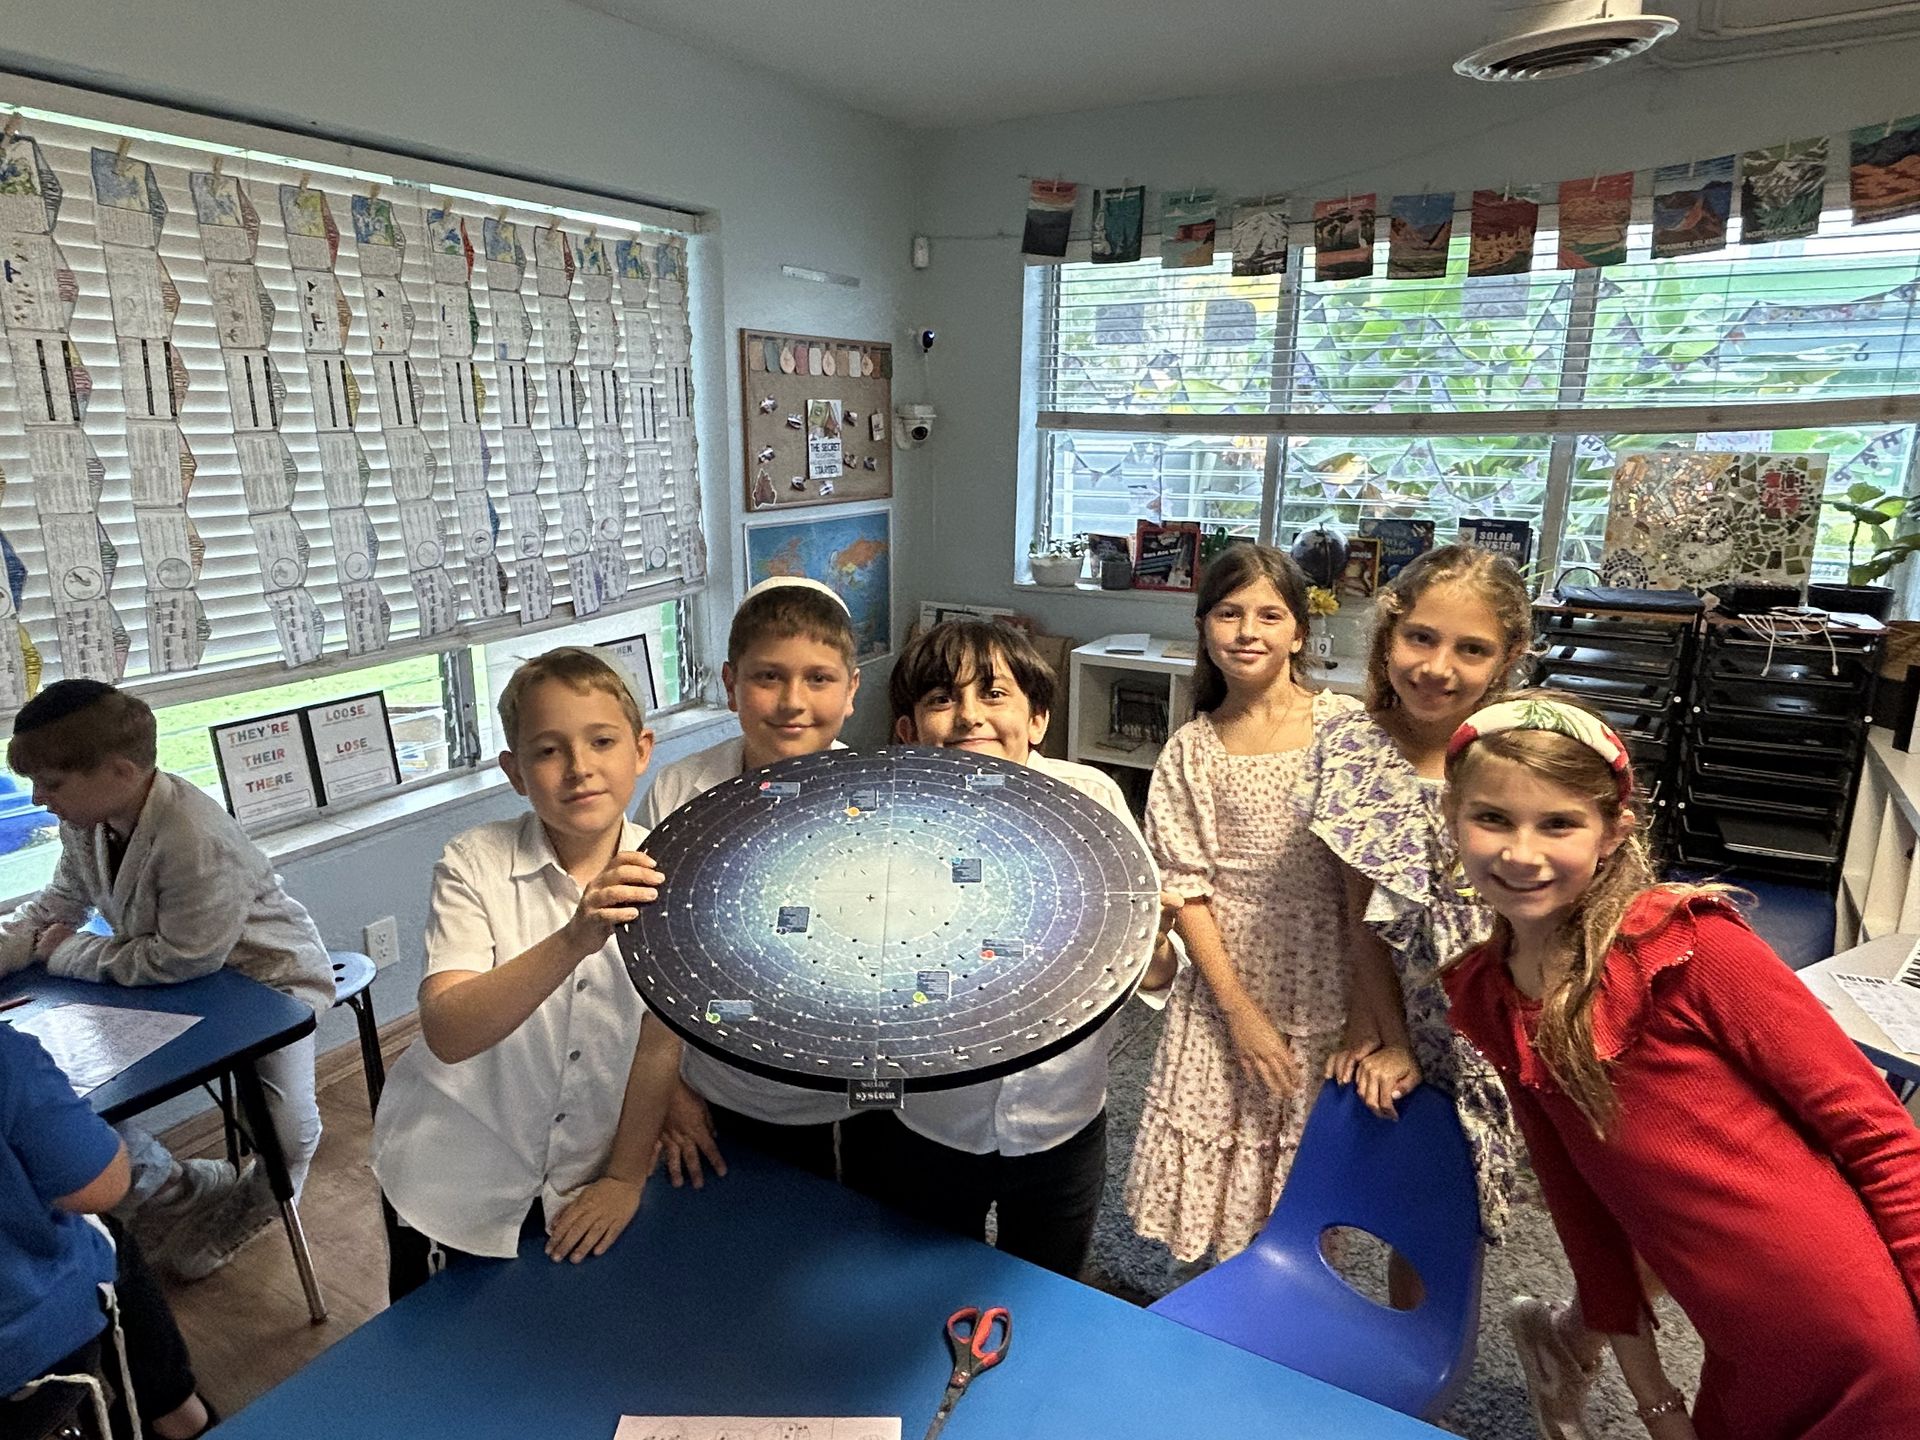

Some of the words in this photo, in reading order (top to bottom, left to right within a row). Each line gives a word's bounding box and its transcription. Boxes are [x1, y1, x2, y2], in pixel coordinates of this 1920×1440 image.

[1479, 531, 1513, 541] SOLAR
[1478, 541, 1521, 551] SYSTEM
[325, 704, 365, 721] LOOSE
[227, 721, 290, 745] THEY'RE
[336, 737, 368, 754] LOSE
[242, 748, 286, 767] THEIR
[245, 772, 294, 793] THERE
[1836, 974, 1886, 985] SOLAR
[855, 1091, 896, 1101] system
